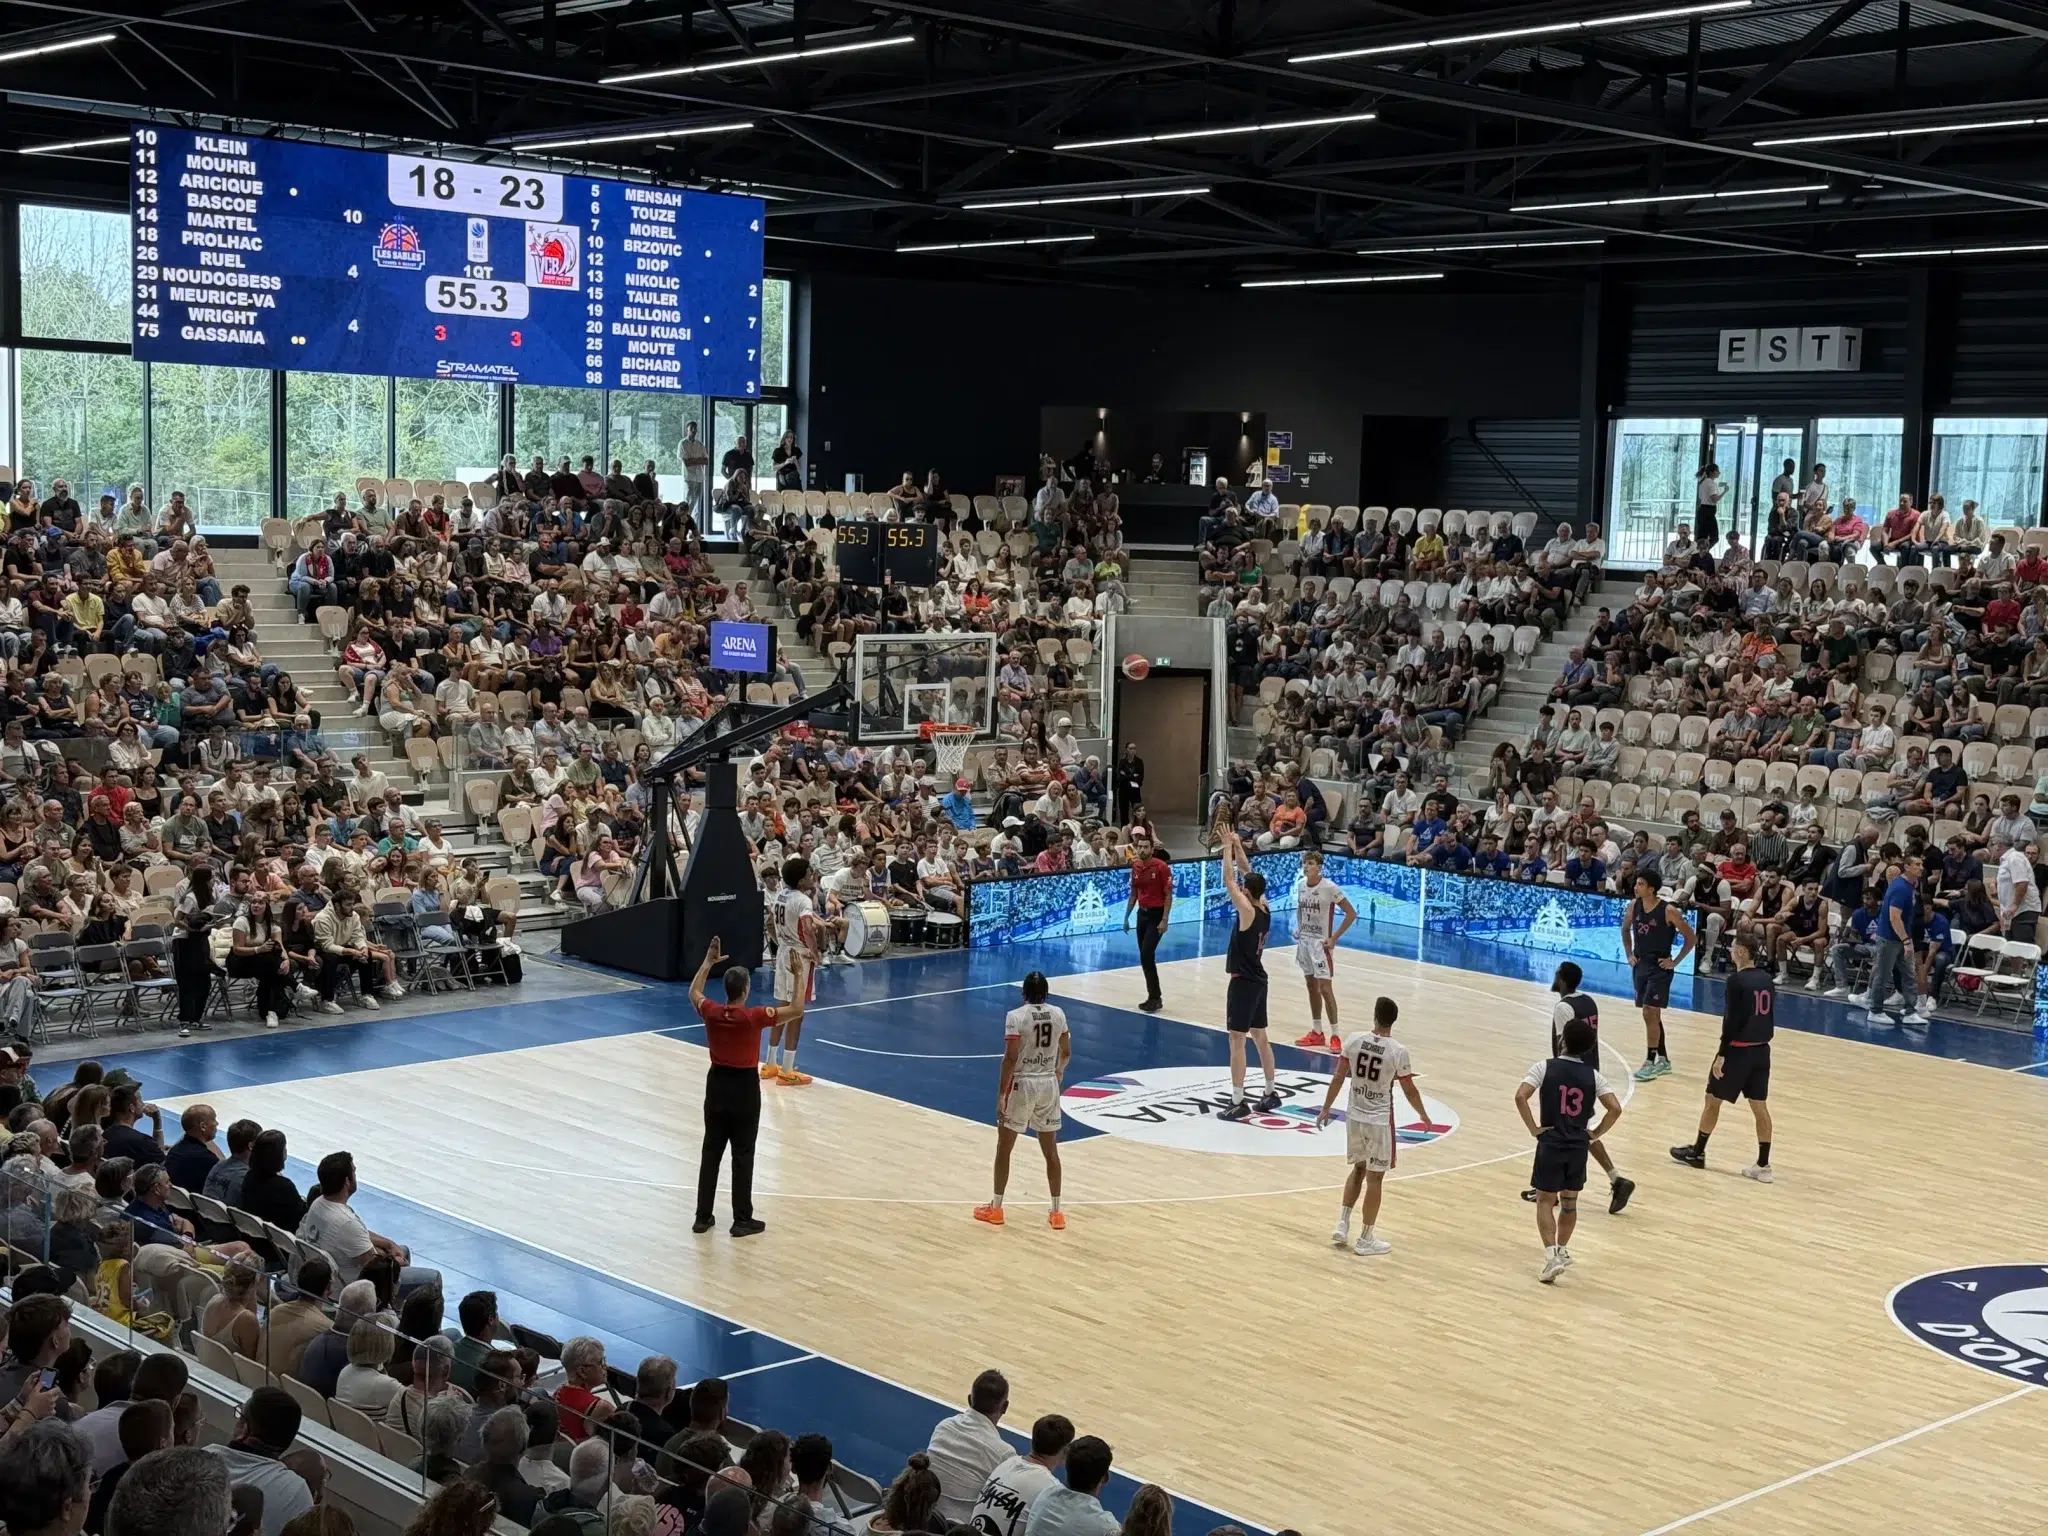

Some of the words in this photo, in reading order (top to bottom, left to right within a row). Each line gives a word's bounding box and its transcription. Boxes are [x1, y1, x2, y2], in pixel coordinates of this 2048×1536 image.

[136, 130, 157, 145] 10
[195, 136, 248, 156] KLEIN
[136, 149, 156, 164] 11
[187, 155, 256, 176] MOUHRI
[136, 168, 158, 184] 12
[180, 173, 263, 196] ARICIQUE
[409, 164, 455, 200] 18
[499, 175, 545, 210] 23
[136, 188, 158, 204] 13
[187, 193, 256, 214] BASCOE
[342, 209, 362, 224] 10
[591, 185, 600, 197] 5
[625, 188, 682, 207] MENSAH
[136, 207, 158, 222] 14
[188, 212, 257, 232] MARTEL
[591, 201, 600, 214] 6
[631, 206, 676, 222] TOUZE
[750, 220, 759, 232] 4
[136, 226, 158, 242] 18
[182, 231, 263, 251] PROLHAC
[591, 219, 600, 231] 7
[630, 223, 676, 240] MOREL
[587, 236, 603, 249] 10
[624, 239, 682, 257] BRZOVIC
[137, 246, 158, 262] 26
[200, 252, 246, 268] RUEL
[348, 264, 358, 278] 4
[587, 252, 603, 266] 12
[637, 258, 669, 272] DIOP
[137, 265, 158, 280] 29
[163, 269, 281, 290] NOUDOGBESS
[587, 270, 603, 282] 13
[625, 273, 680, 290] NIKOLIC
[749, 285, 757, 297] 2
[137, 284, 158, 300] 31
[170, 288, 276, 308] MEURICE-VA
[438, 280, 508, 312] 55.3
[587, 287, 603, 300] 15
[627, 290, 678, 306] TAULER
[137, 304, 159, 319] 44
[188, 308, 258, 326] WRIGHT
[348, 319, 358, 333] 4
[587, 304, 603, 317] 19
[623, 306, 681, 323] BILLONG
[748, 317, 757, 329] 7
[138, 322, 159, 338] 75
[181, 326, 265, 345] GASSAMA
[434, 325, 447, 341] 3
[510, 331, 522, 347] 3
[586, 321, 603, 333] 20
[612, 323, 647, 337] BALU
[651, 326, 691, 340] KUASI
[586, 338, 603, 350] 25
[628, 341, 675, 356] MOUTE
[747, 349, 756, 361] 7
[436, 359, 519, 375] STRAMATEL
[586, 354, 603, 368] 66
[622, 357, 681, 372] BICHARD
[586, 371, 603, 384] 98
[621, 374, 681, 389] BERCHEL
[746, 381, 755, 393] 3
[838, 526, 869, 545] 55.3
[888, 528, 924, 547] 55.3
[721, 636, 756, 651] ARENA
[1754, 990, 1771, 1016] 10
[1034, 1023, 1052, 1048] 19
[1356, 1052, 1383, 1081] 66
[1559, 1085, 1584, 1116] 13
